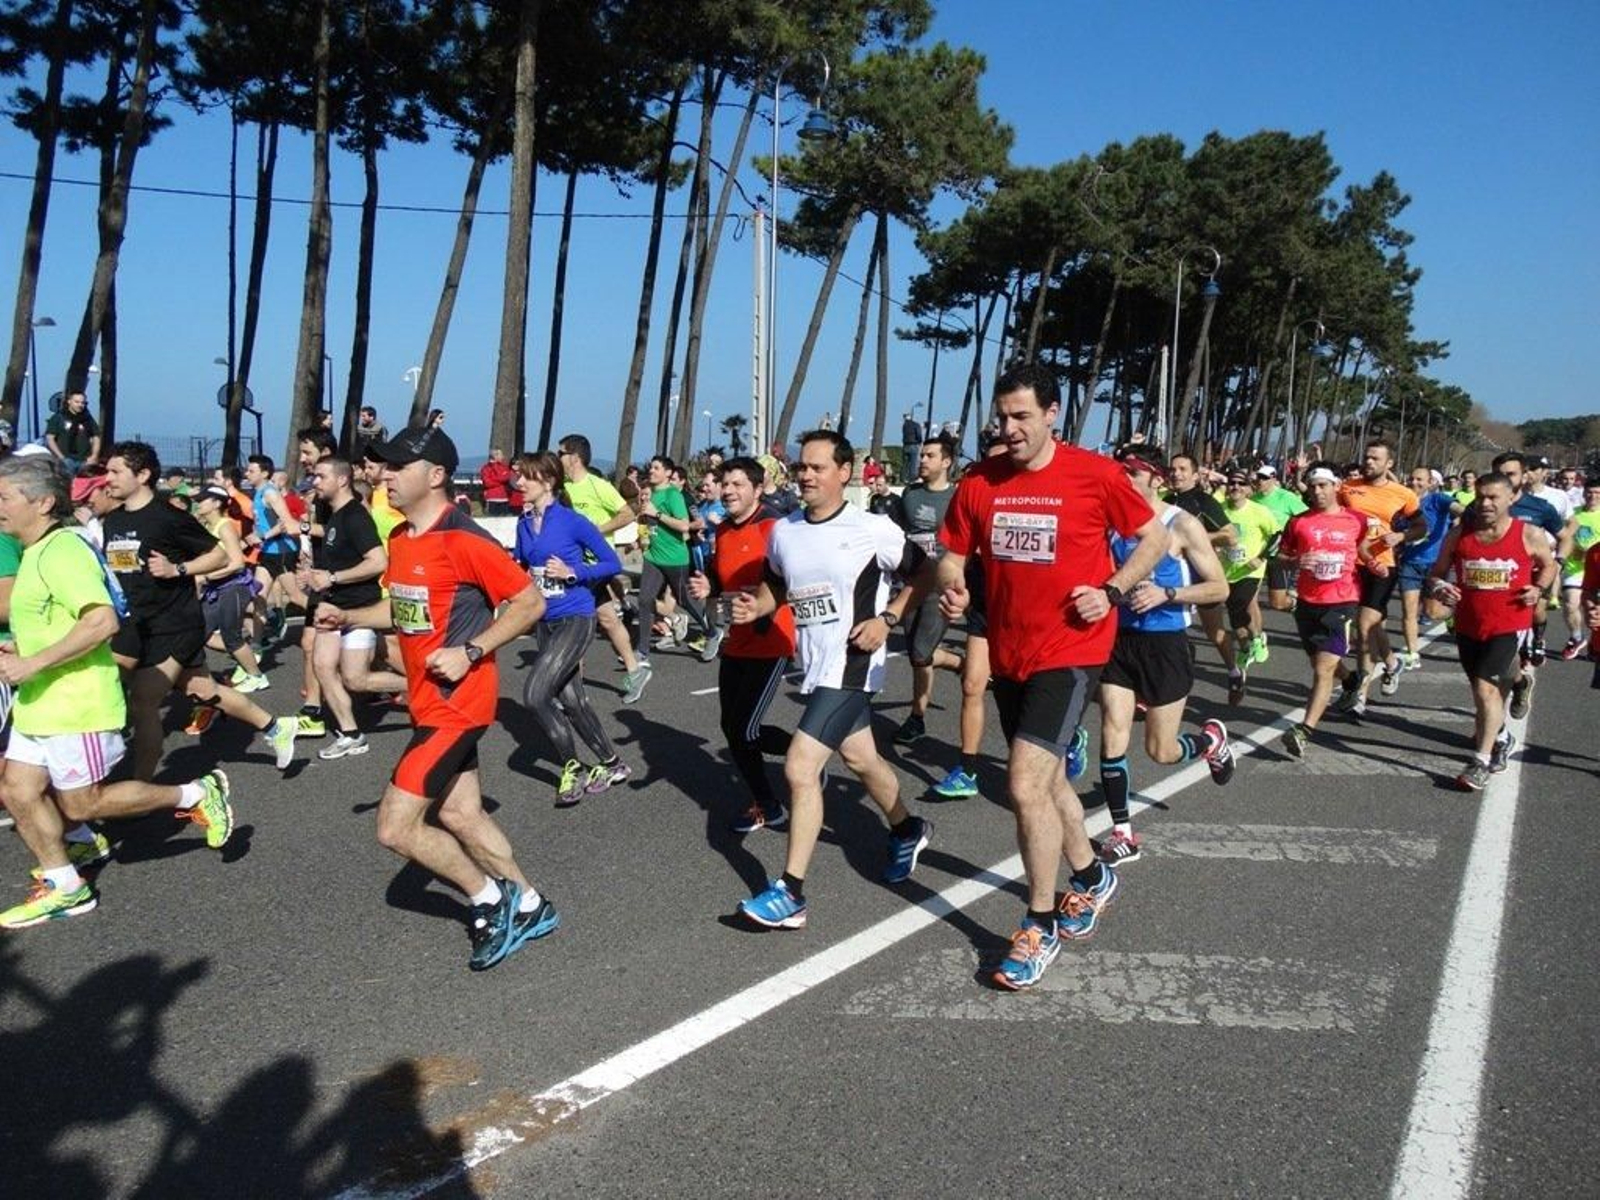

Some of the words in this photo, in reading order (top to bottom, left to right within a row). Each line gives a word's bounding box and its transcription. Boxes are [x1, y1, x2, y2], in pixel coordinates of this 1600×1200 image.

[994, 497, 1063, 506] METROPOLITAN
[1005, 530, 1041, 551] 2125
[1472, 570, 1502, 583] 4683
[795, 599, 827, 619] 3579
